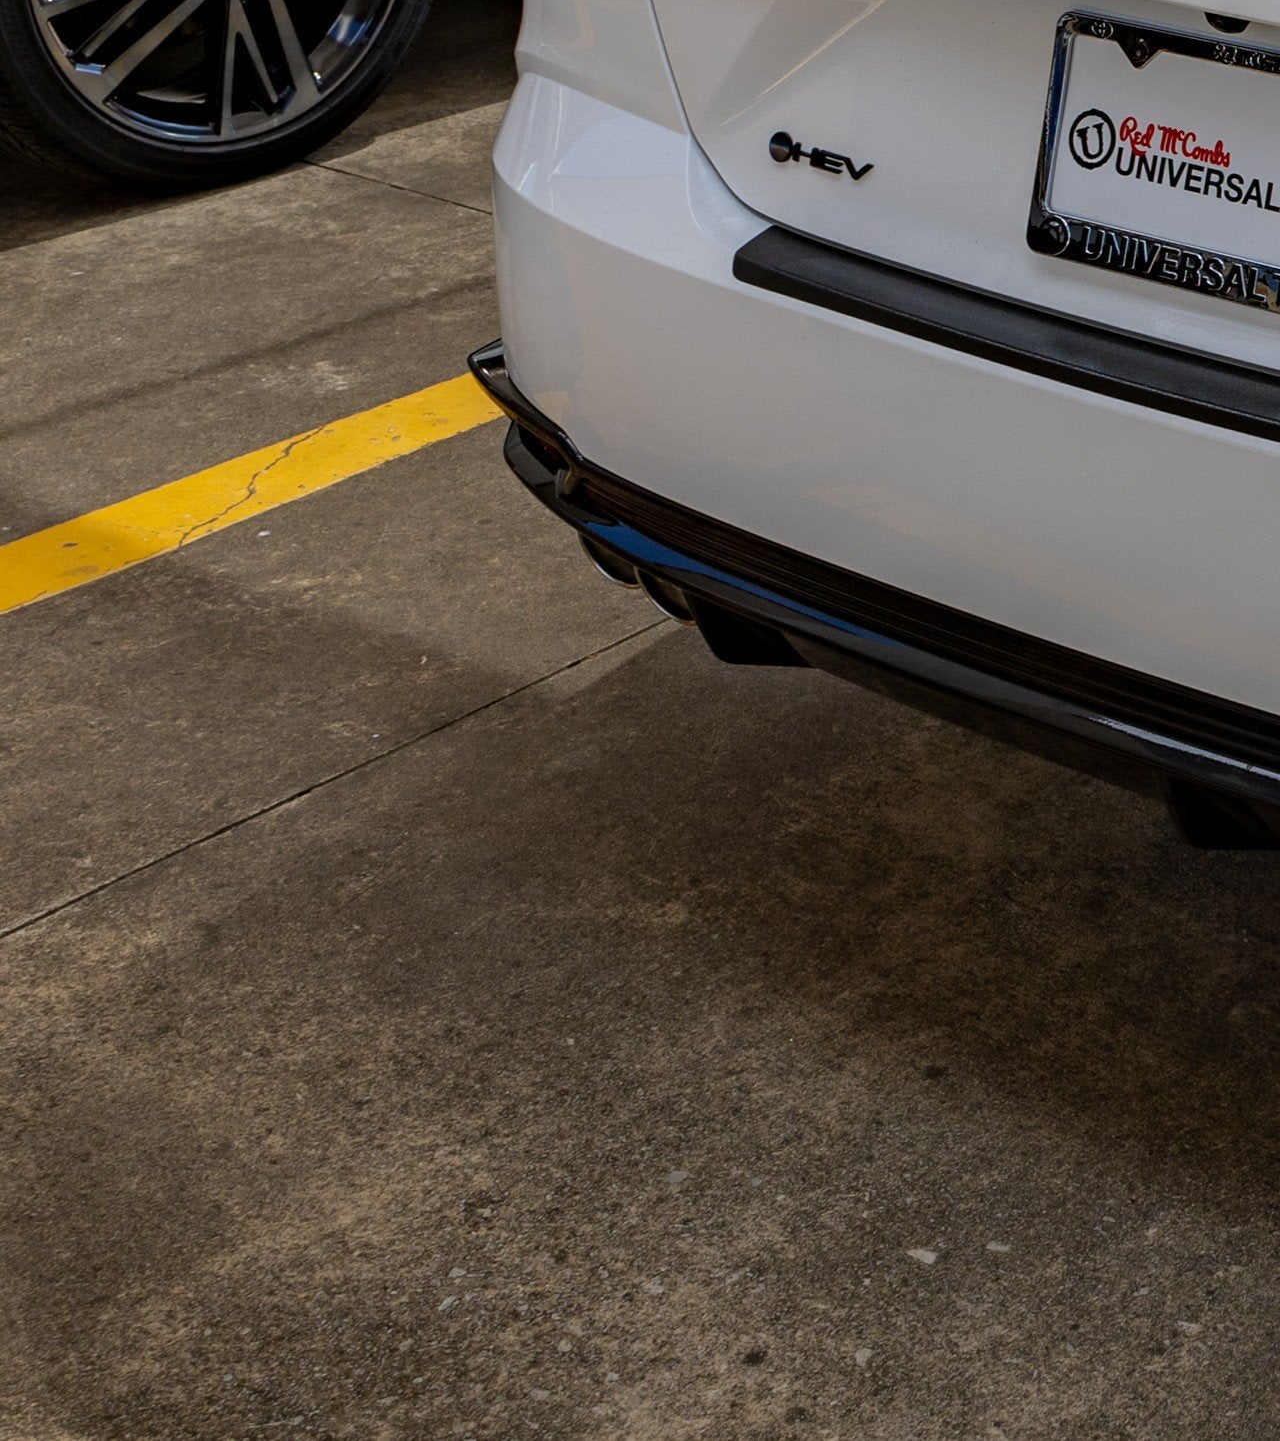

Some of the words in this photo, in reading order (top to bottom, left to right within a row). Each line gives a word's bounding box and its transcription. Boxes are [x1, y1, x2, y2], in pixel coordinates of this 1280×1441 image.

[791, 141, 875, 181] HEV
[1119, 116, 1155, 157] Red
[1157, 123, 1231, 168] McCombs
[1115, 146, 1280, 214] UNIVERSAL
[1083, 225, 1268, 304] UNIVERSAL
